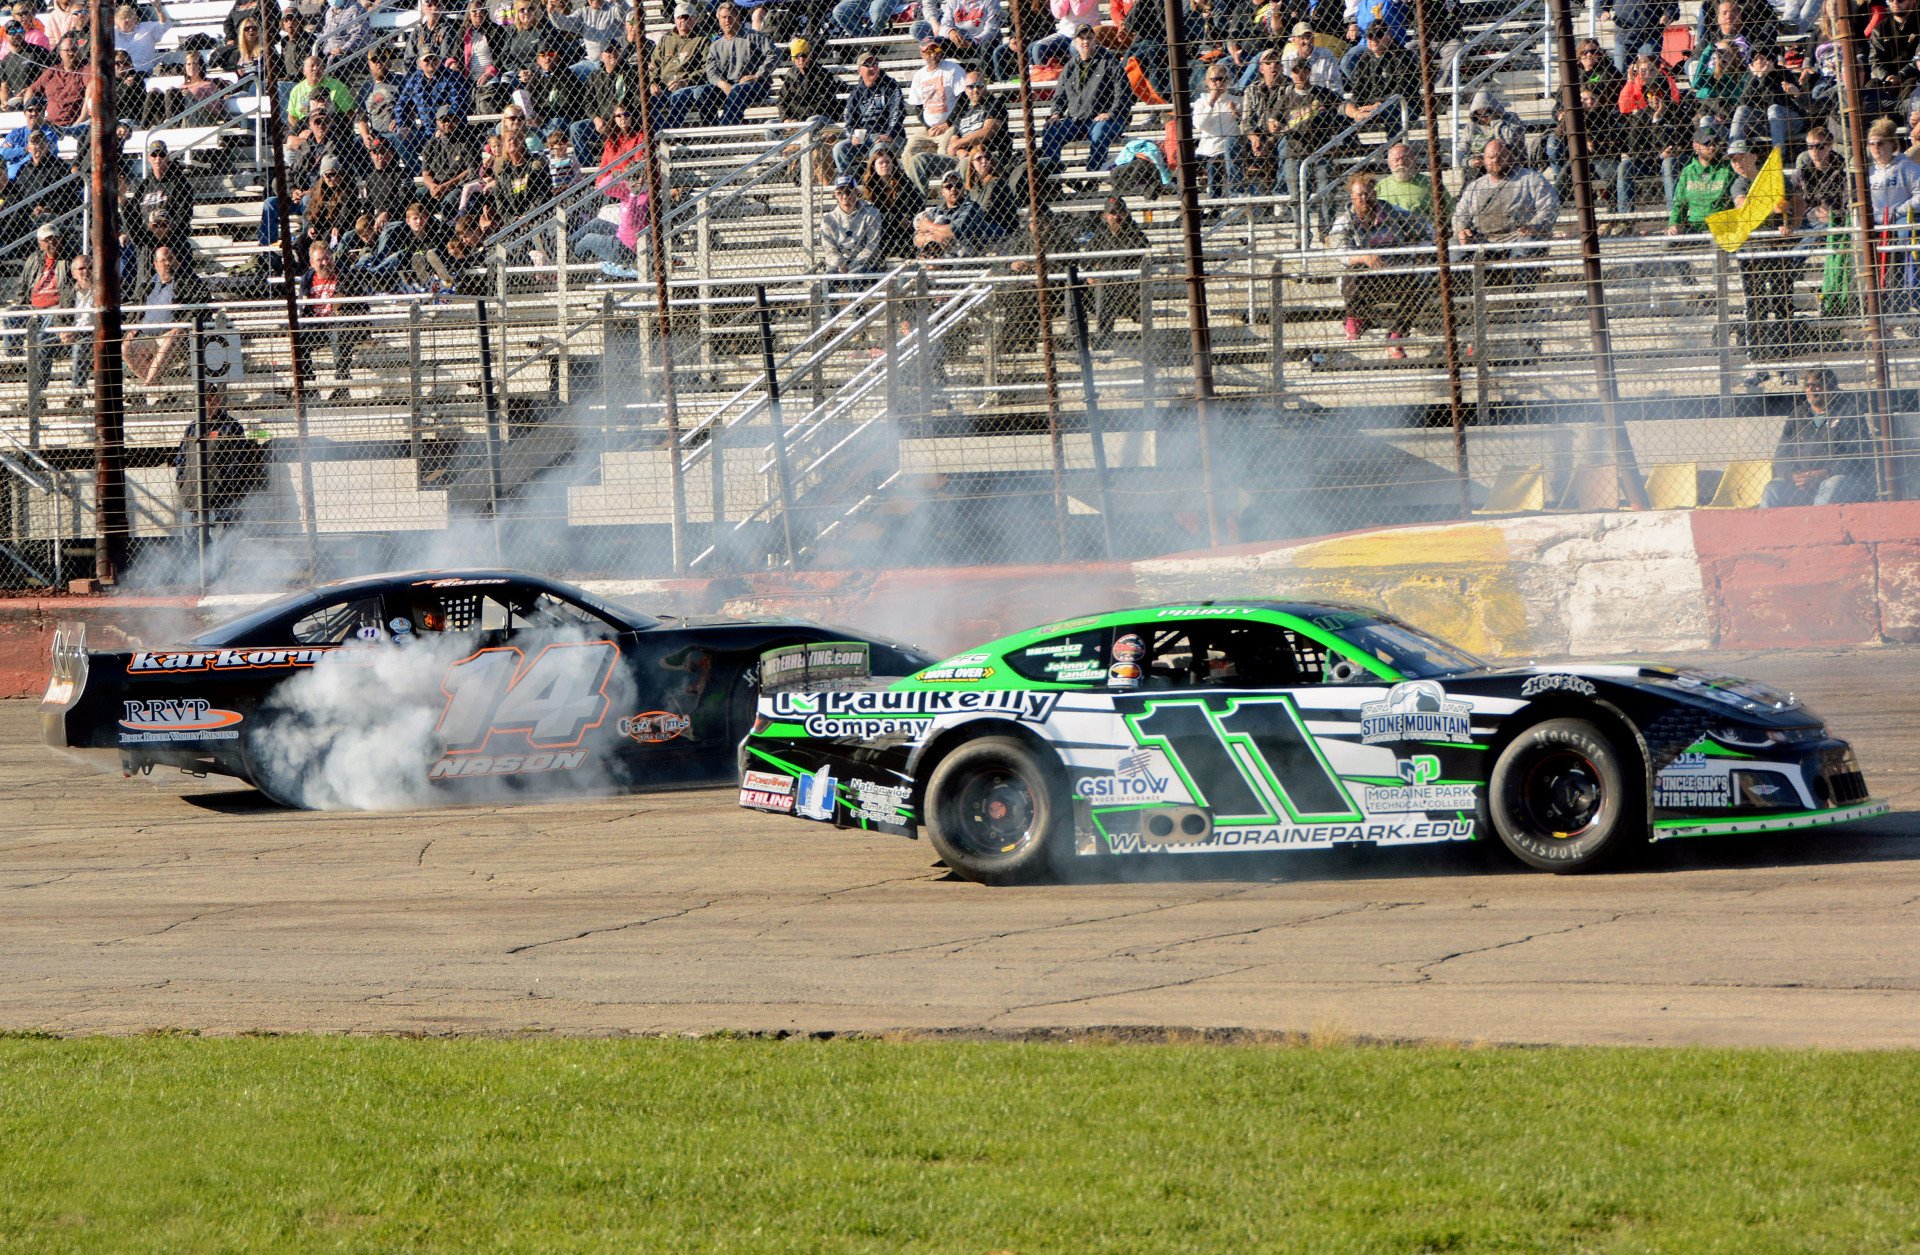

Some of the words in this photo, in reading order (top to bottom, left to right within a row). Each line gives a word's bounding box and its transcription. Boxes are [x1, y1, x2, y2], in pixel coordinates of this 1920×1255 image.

[955, 667, 984, 678] OVER
[1058, 668, 1107, 680] Landing
[436, 640, 620, 755] 14
[926, 690, 1056, 722] Reilly
[124, 700, 210, 722] RRVP
[805, 715, 932, 740] Company
[1363, 714, 1401, 735] STONE
[1405, 715, 1469, 734] MOUNTAIN
[429, 750, 589, 779] NASON
[1124, 696, 1366, 825] 11
[850, 778, 911, 798] Nationwide
[1079, 780, 1114, 796] GSI
[1119, 778, 1169, 795] TOW
[1368, 788, 1432, 800] MORAINE
[1435, 786, 1472, 797] PARK
[1662, 777, 1695, 790] UNCLE
[1696, 777, 1728, 790] SAM'S
[740, 789, 794, 807] BEHLING
[1662, 792, 1728, 807] FIREWORKS
[1109, 820, 1473, 853] WMORAINEPARK.EDU
